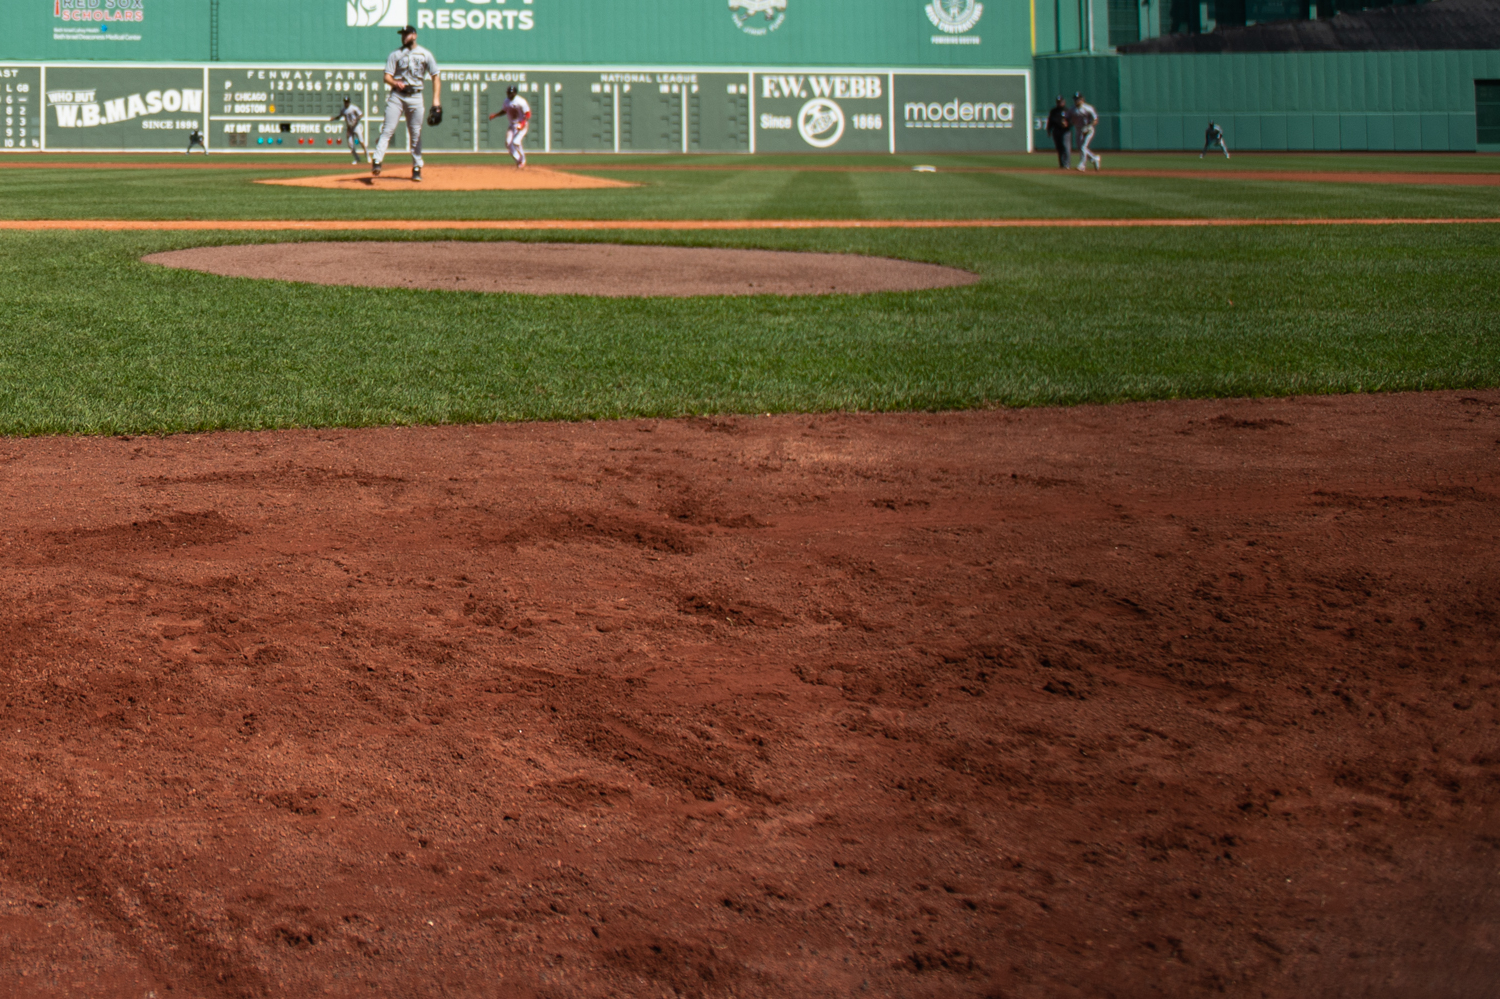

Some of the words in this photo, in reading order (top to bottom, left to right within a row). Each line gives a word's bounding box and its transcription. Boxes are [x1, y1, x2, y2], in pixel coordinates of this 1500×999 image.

[62, 9, 144, 22] SCHOLARS
[417, 9, 535, 30] RESORTS
[247, 70, 313, 79] FENWAY
[324, 71, 367, 80] PARK
[424, 72, 480, 81] AERICAN
[485, 73, 526, 82] LEAGUE
[600, 73, 652, 83] NATIONAL
[656, 74, 698, 84] LEAGUE
[6, 83, 13, 93] L
[16, 83, 29, 93] GB
[224, 81, 232, 91] P
[277, 81, 284, 91] 2
[286, 81, 293, 91] 3
[297, 81, 305, 91] 4
[306, 81, 313, 91] 5
[314, 81, 322, 91] 6
[326, 81, 333, 91] 7
[334, 81, 342, 91] 8
[343, 81, 350, 91] 9
[353, 81, 364, 91] 10
[371, 81, 379, 91] R
[761, 75, 808, 99] F.W.
[807, 75, 882, 99] WEBB
[5, 95, 13, 105] 6
[47, 91, 73, 103] WHO
[74, 91, 96, 103] BUT
[234, 93, 267, 102] CHICAGO
[234, 104, 267, 113] BOSTON
[904, 97, 1014, 121] moderna
[142, 120, 174, 129] SINCE
[175, 120, 199, 130] 1898
[760, 113, 792, 130] Since
[851, 114, 882, 130] 1866
[224, 124, 235, 133] AT
[236, 124, 252, 133] BAT
[258, 124, 281, 133] BALL
[290, 124, 321, 133] STRIKE
[324, 124, 343, 134] OUT
[4, 139, 14, 148] 10
